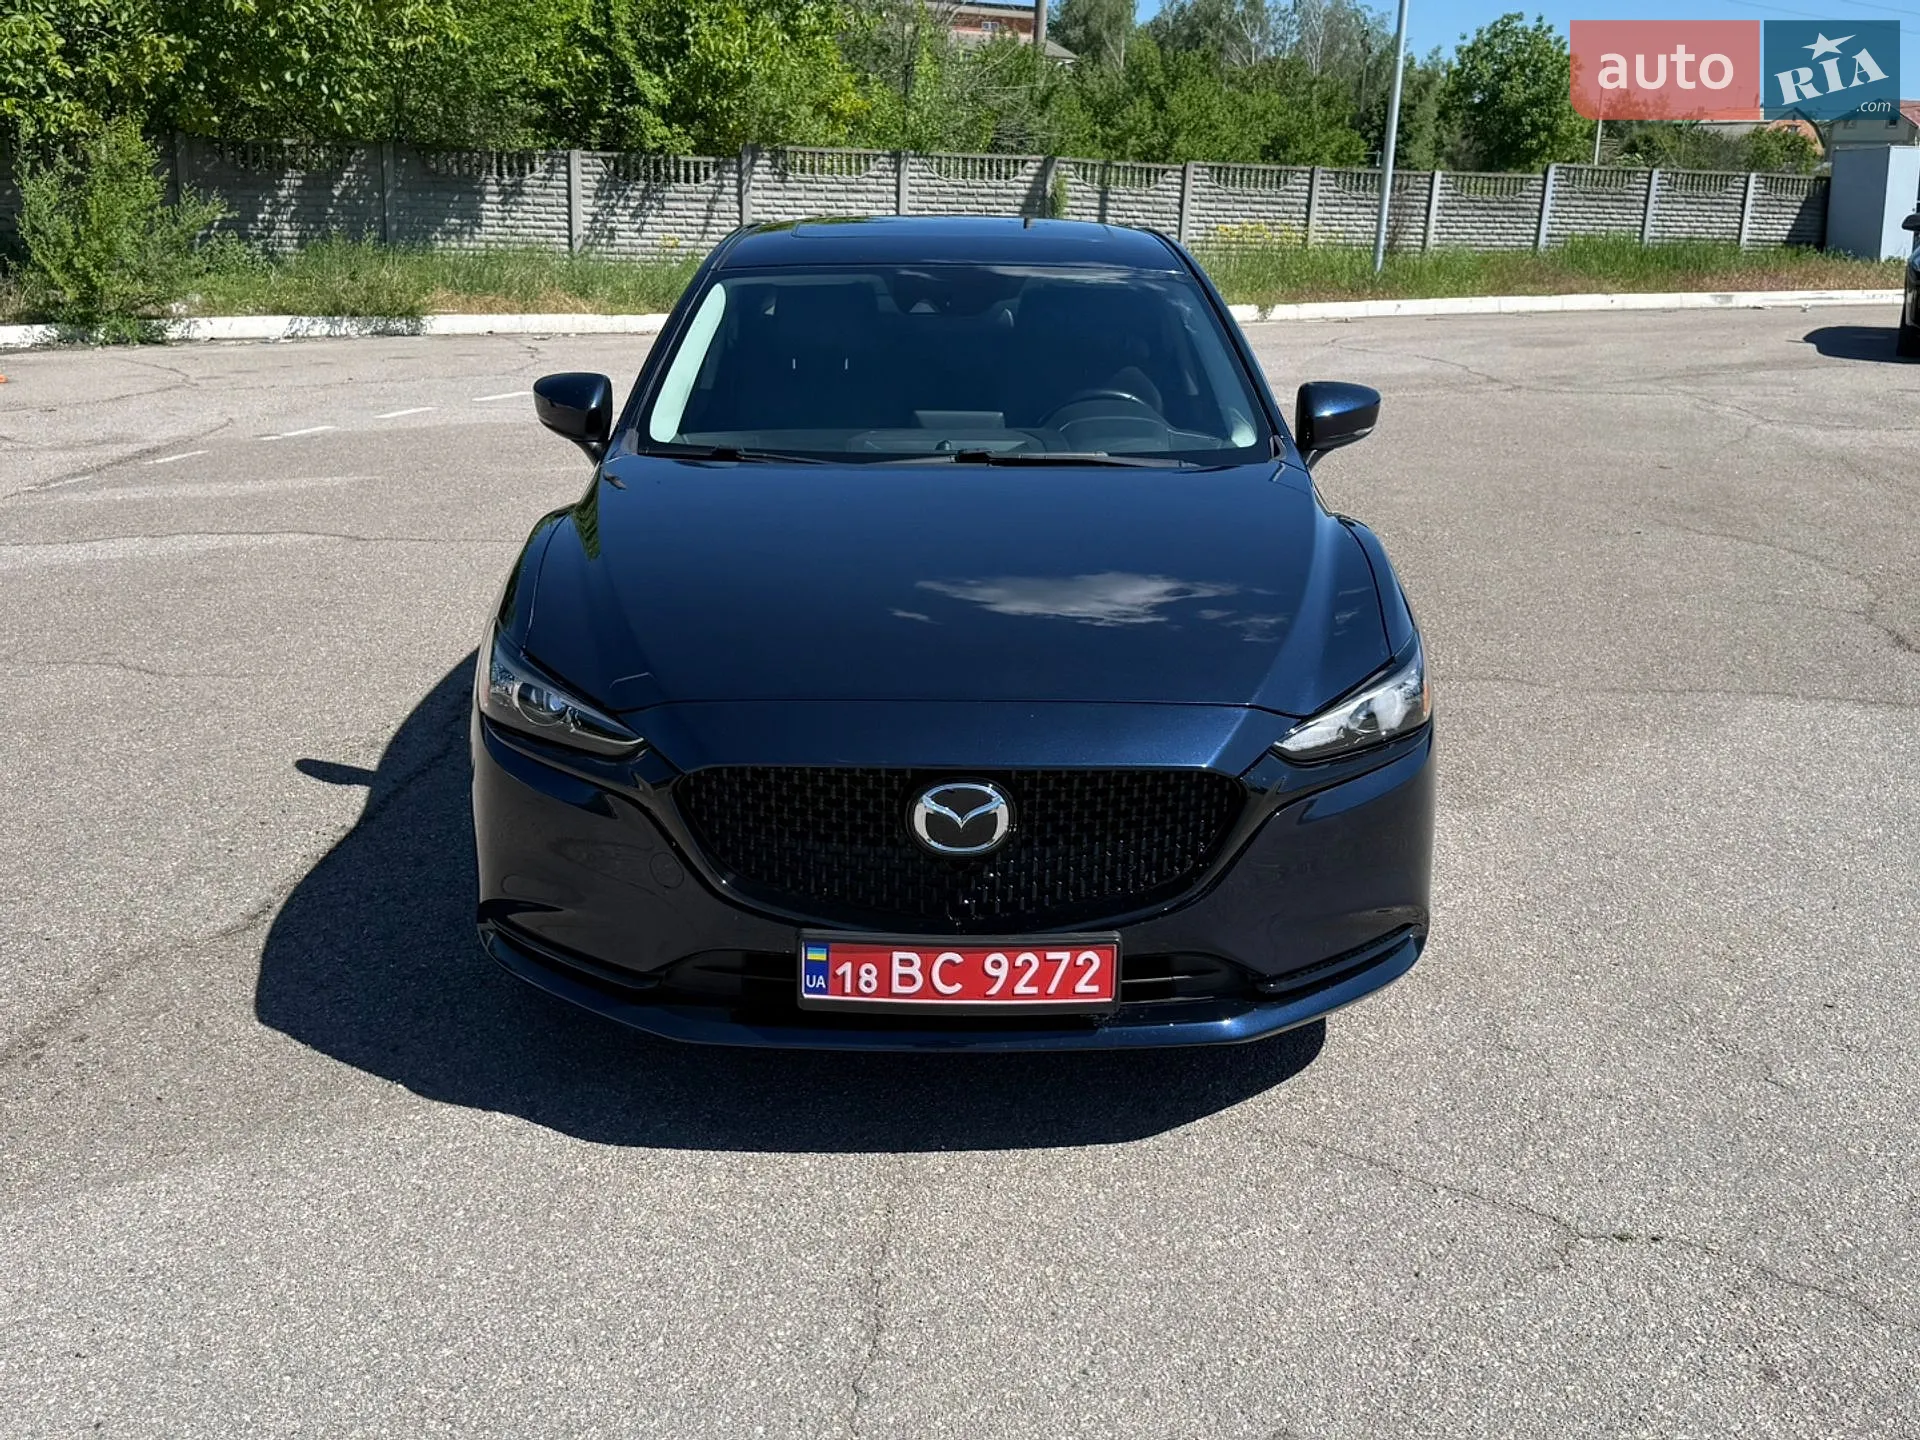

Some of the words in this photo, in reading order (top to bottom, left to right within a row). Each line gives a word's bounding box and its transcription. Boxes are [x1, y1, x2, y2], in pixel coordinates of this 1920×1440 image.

[806, 975, 826, 989] UA
[834, 961, 878, 994] 18
[891, 951, 964, 995] BC
[983, 950, 1101, 996] 9272
